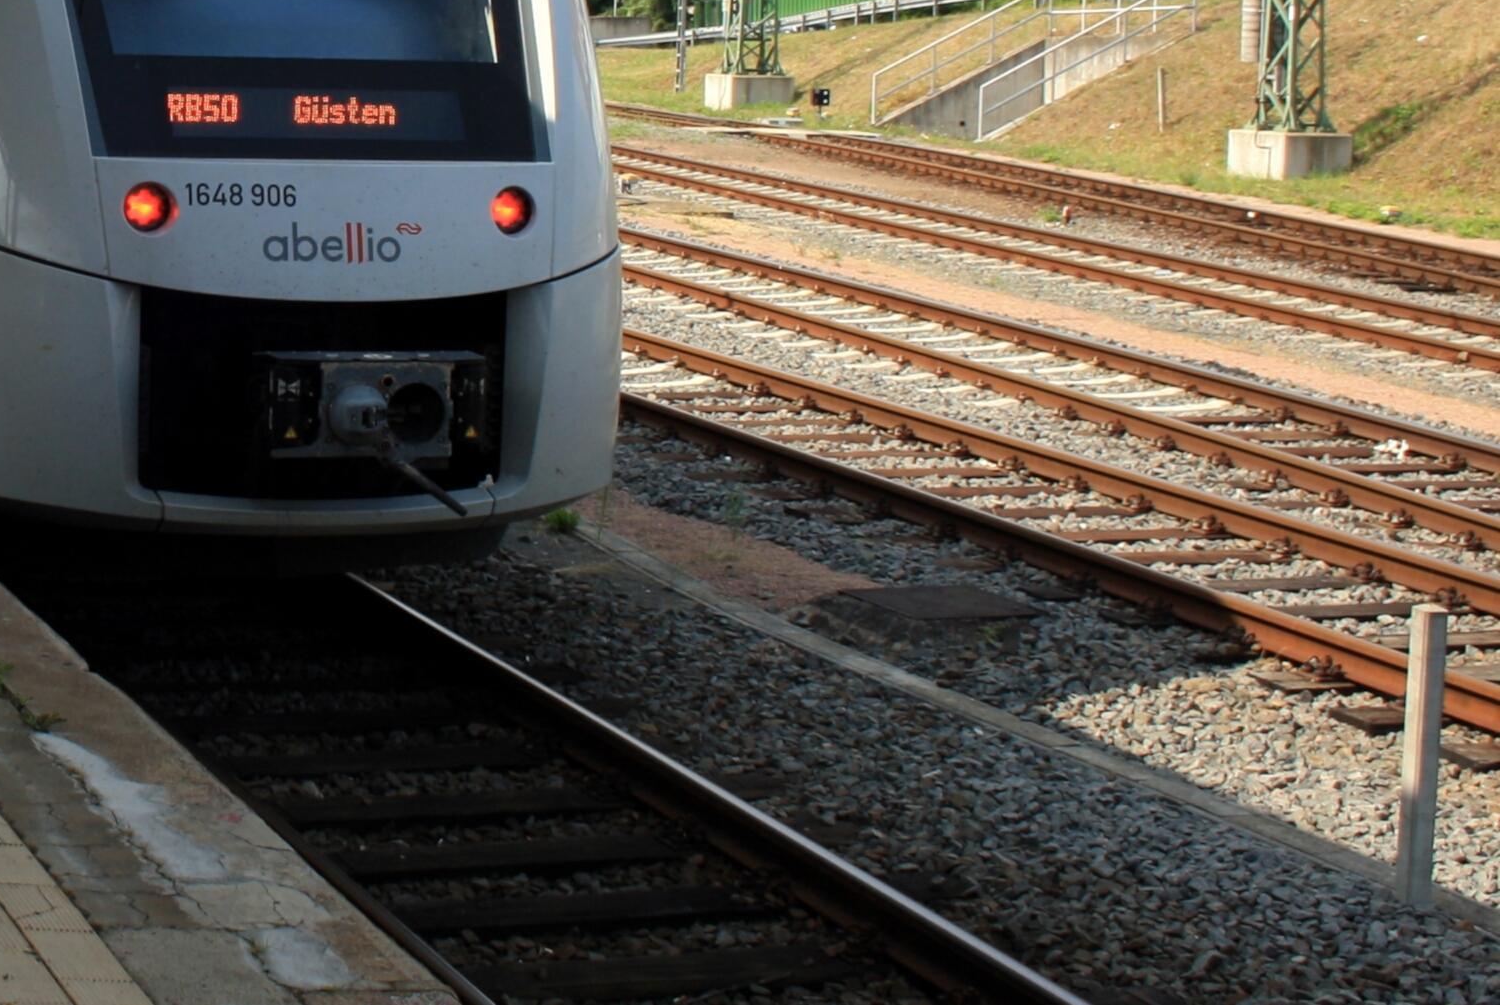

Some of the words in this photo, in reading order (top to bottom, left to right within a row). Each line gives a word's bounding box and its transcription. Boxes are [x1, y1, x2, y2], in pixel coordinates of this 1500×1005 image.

[167, 92, 240, 123] RB50
[294, 94, 398, 126] Güsten
[184, 183, 244, 206] 1648
[251, 184, 298, 208] 906
[262, 221, 402, 264] abellio
